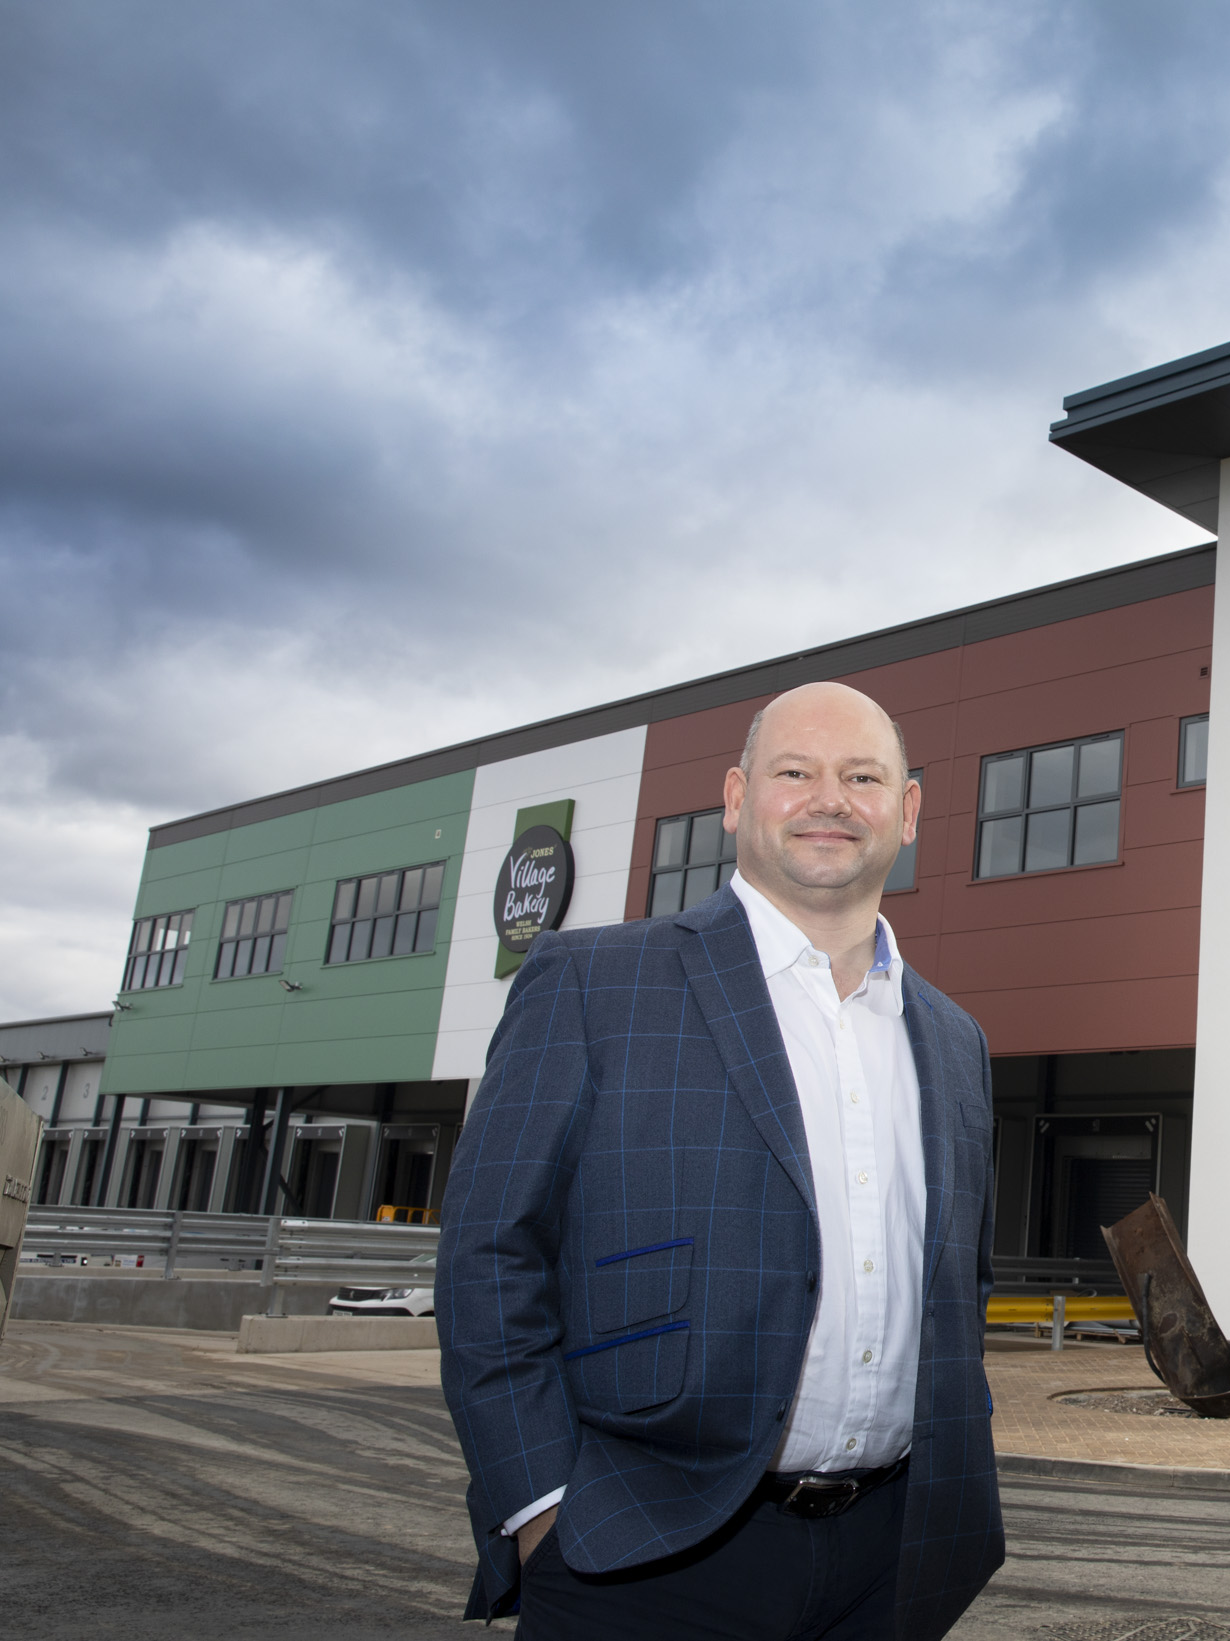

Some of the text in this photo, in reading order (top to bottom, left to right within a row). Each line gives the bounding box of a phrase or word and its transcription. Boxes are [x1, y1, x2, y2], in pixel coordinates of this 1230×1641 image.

[530, 846, 554, 859] JONES
[510, 852, 556, 898] Village
[503, 890, 550, 924] Bakery
[505, 925, 541, 936] FAMILY BAKERS
[41, 1085, 49, 1100] 2
[83, 1083, 91, 1098] 3
